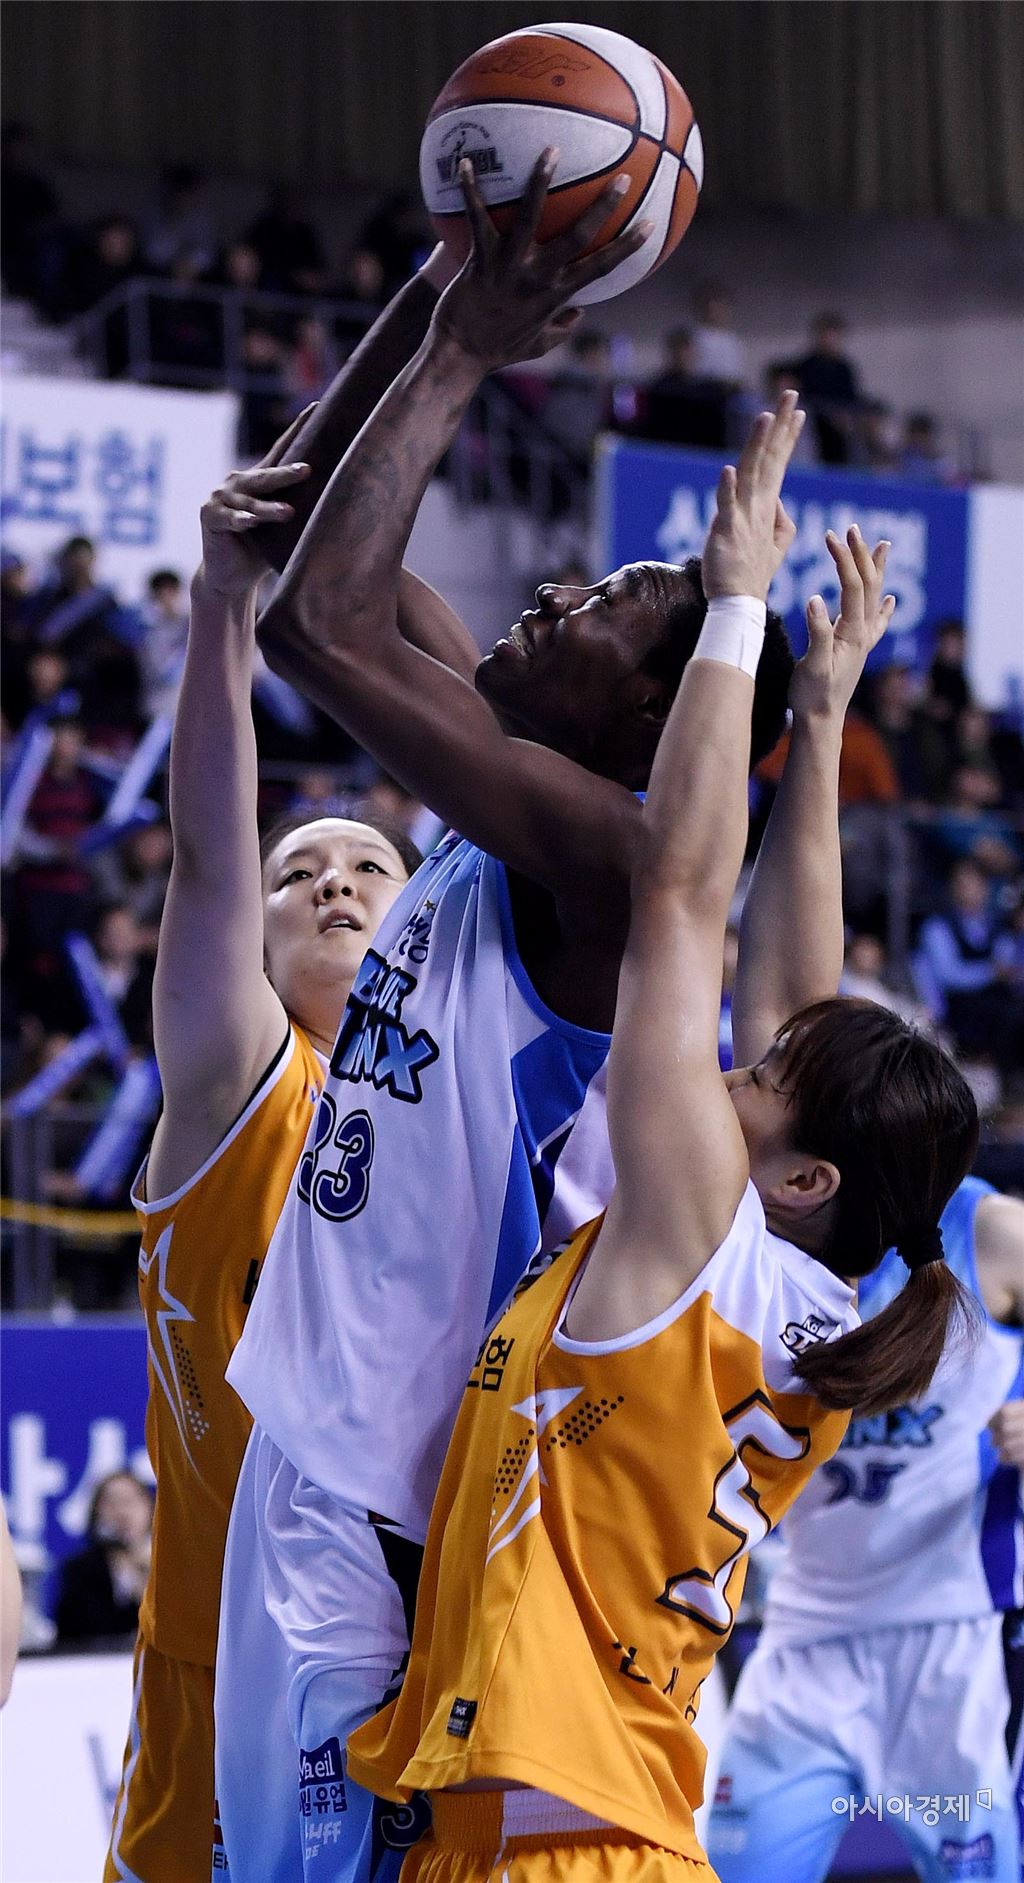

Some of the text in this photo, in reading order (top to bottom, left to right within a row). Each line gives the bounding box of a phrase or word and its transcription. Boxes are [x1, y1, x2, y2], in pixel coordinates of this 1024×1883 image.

[0, 424, 167, 546] 보험
[330, 1002, 440, 1104] INX
[656, 1388, 811, 1637] 5
